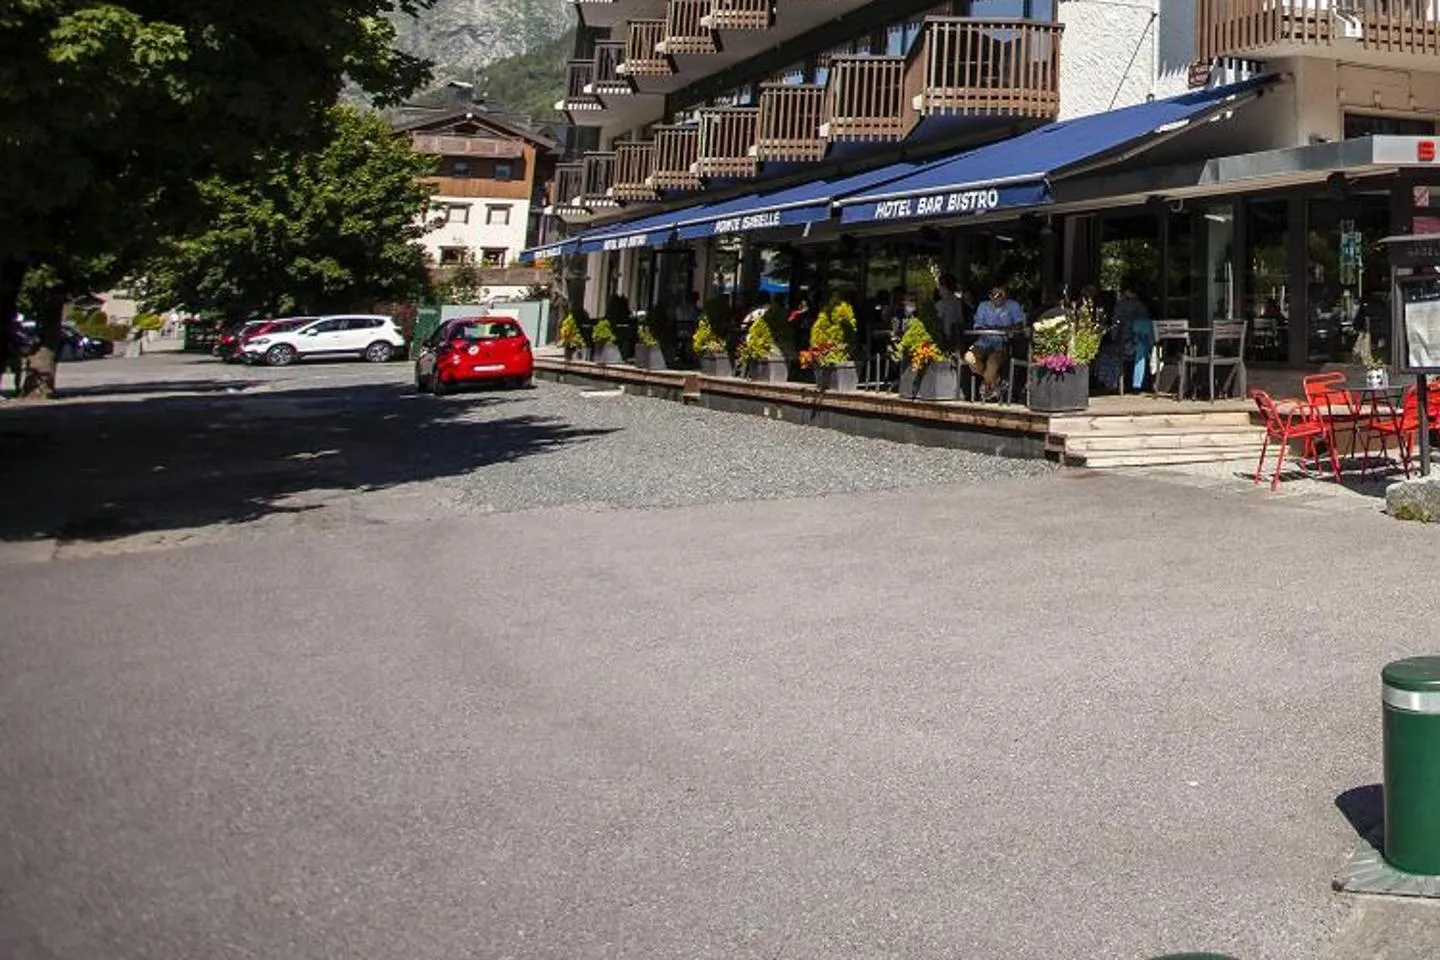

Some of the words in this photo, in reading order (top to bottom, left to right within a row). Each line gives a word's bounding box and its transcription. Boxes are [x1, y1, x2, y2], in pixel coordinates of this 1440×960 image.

[875, 199, 911, 218] HOTEL
[917, 195, 943, 214] BAR
[946, 189, 998, 210] BISTRO
